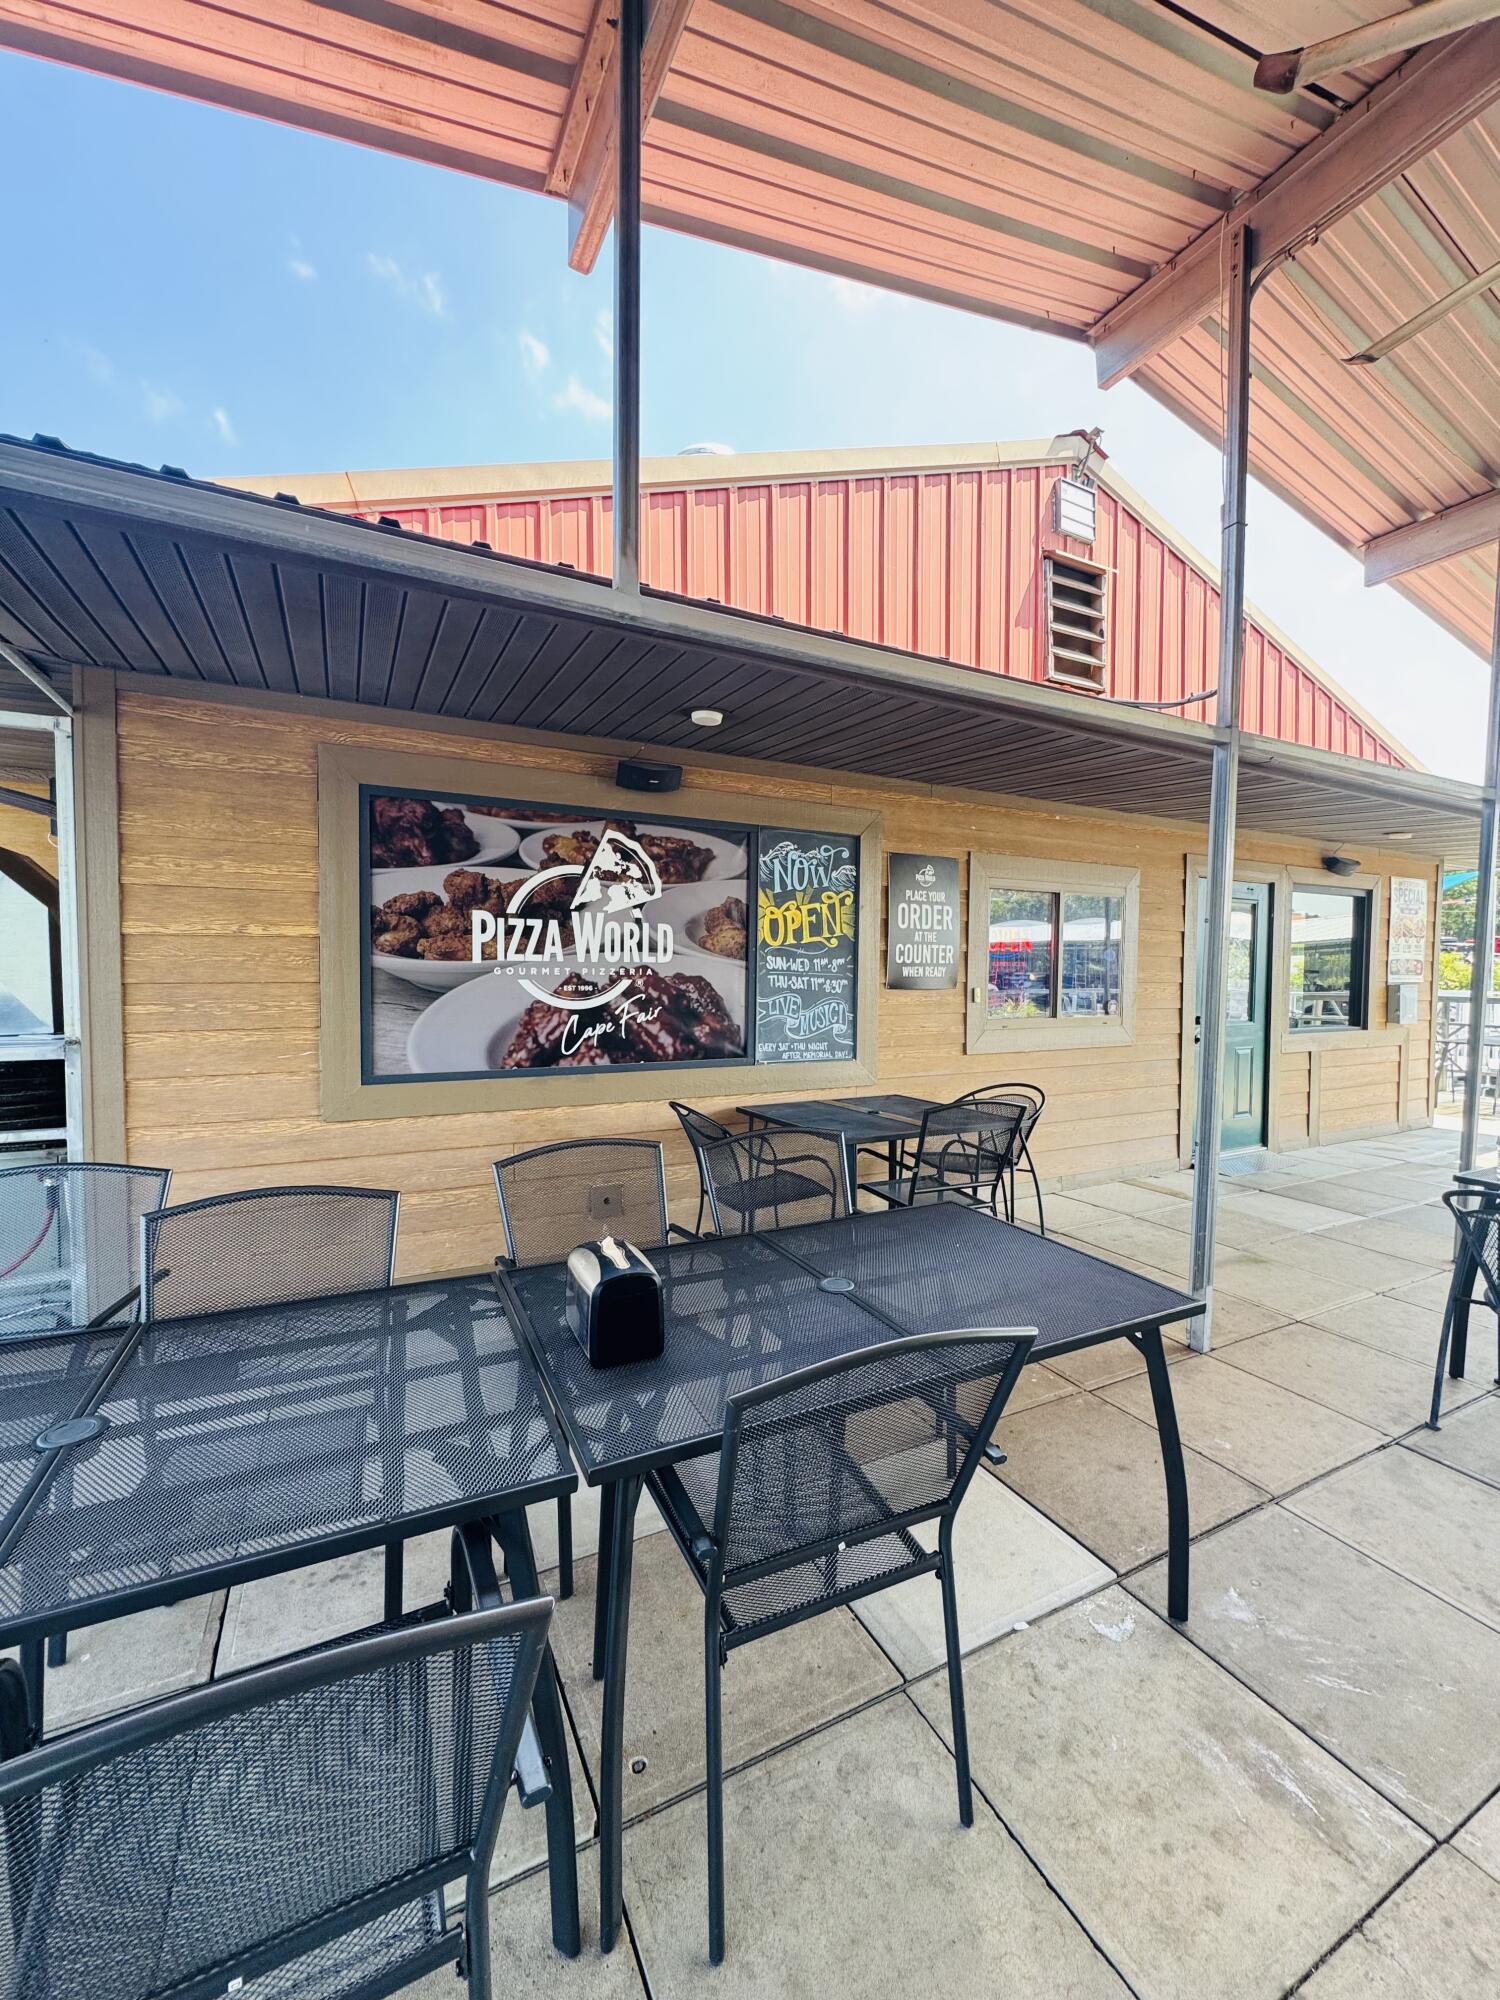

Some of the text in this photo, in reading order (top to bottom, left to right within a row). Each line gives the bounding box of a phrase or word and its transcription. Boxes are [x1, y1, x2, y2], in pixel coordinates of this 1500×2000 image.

[773, 845, 849, 893] NOW
[905, 889, 946, 902] PLACE YOUR
[764, 891, 853, 947] OPEN
[897, 903, 953, 930] ORDER
[471, 910, 674, 964] PIZZA WORLD
[914, 931, 937, 942] AT THE
[895, 943, 954, 964] COUNTER
[494, 966, 653, 977] GOURMET PIZZERIA
[902, 966, 947, 977] WHEN READY
[768, 996, 800, 1017] LIVE
[561, 994, 663, 1055] Cape Fair
[758, 1043, 777, 1052] EVERY
[808, 1042, 829, 1051] NIGHT
[802, 1051, 833, 1059] MEMORIAL
